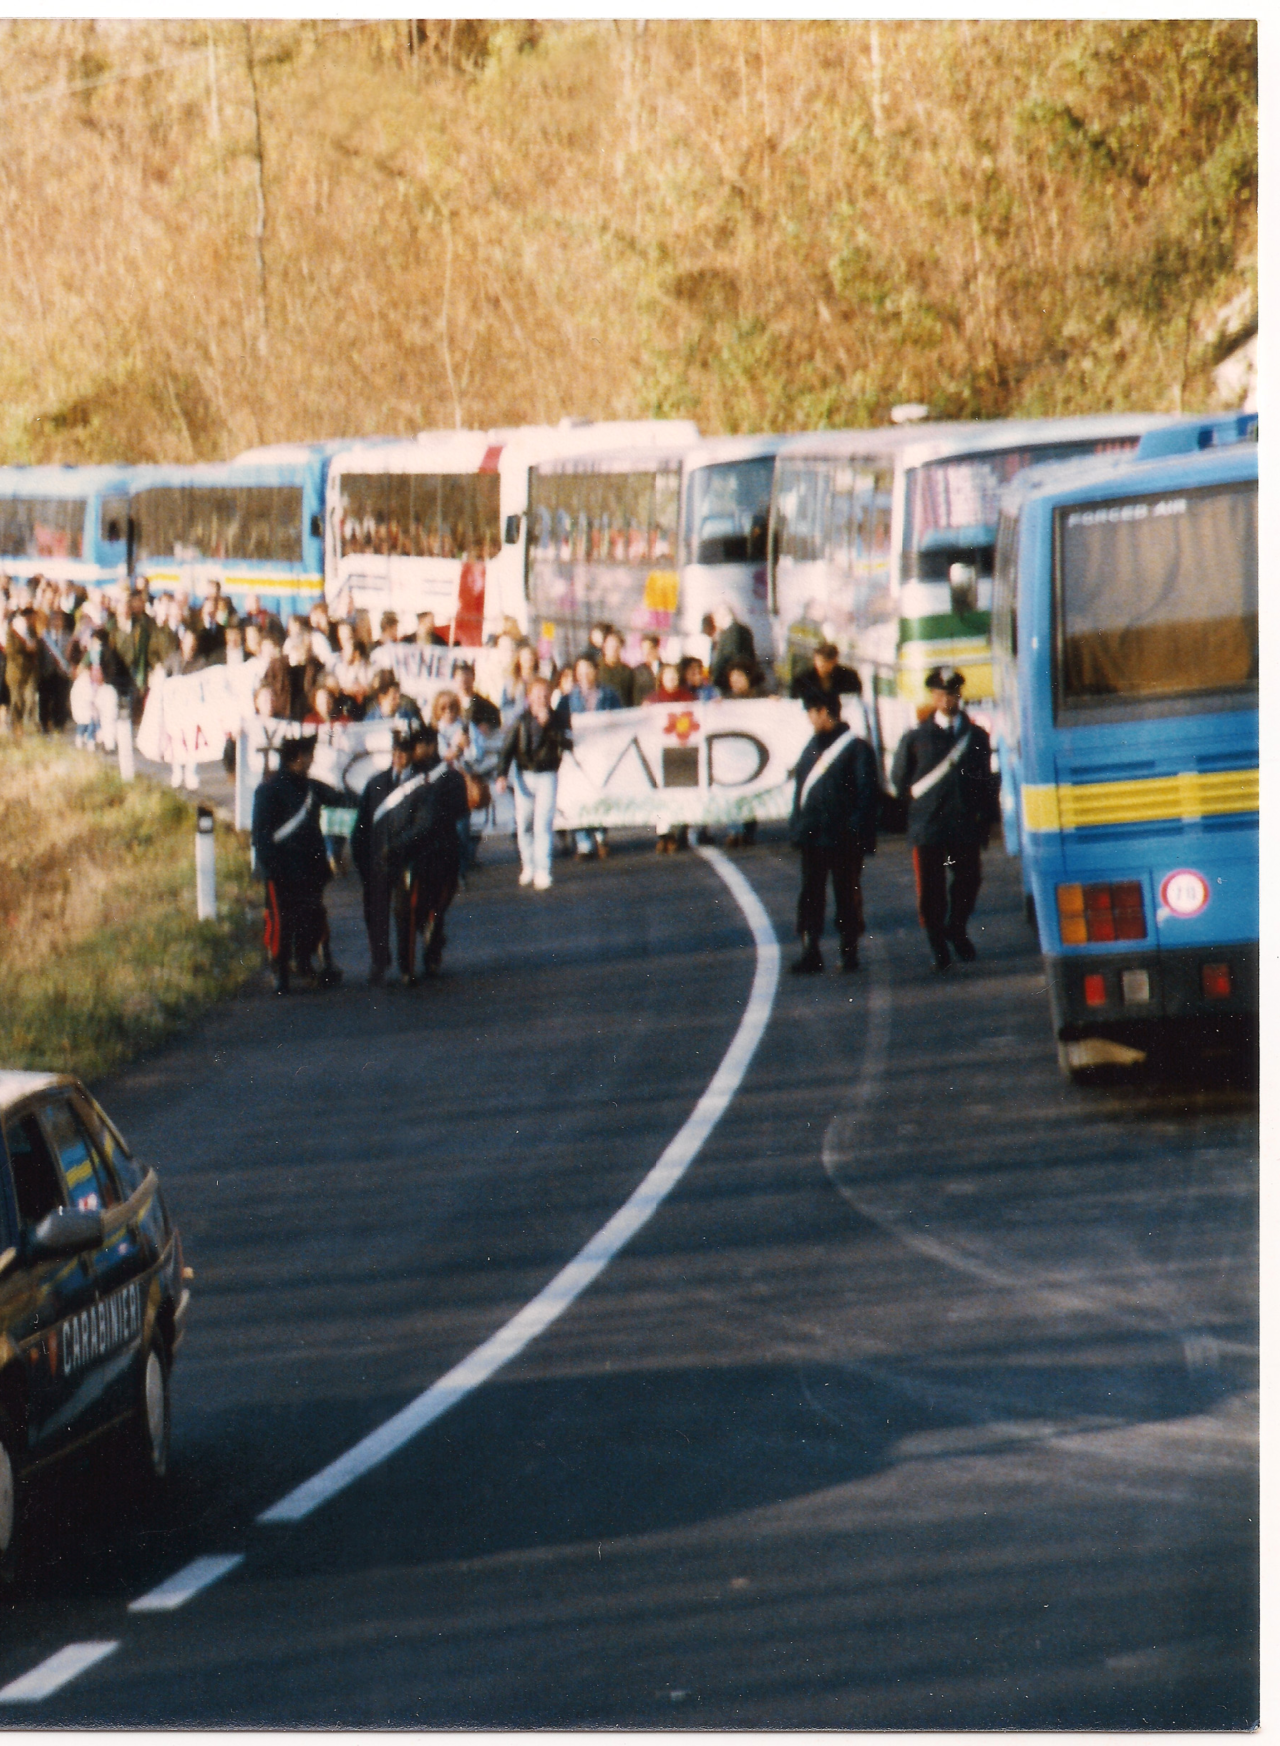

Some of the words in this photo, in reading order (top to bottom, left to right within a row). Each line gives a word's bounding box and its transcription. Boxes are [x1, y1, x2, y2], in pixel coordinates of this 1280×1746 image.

[1067, 503, 1148, 528] FORCED
[1152, 498, 1187, 517] AIR
[62, 1281, 141, 1377] CARABINIERI
